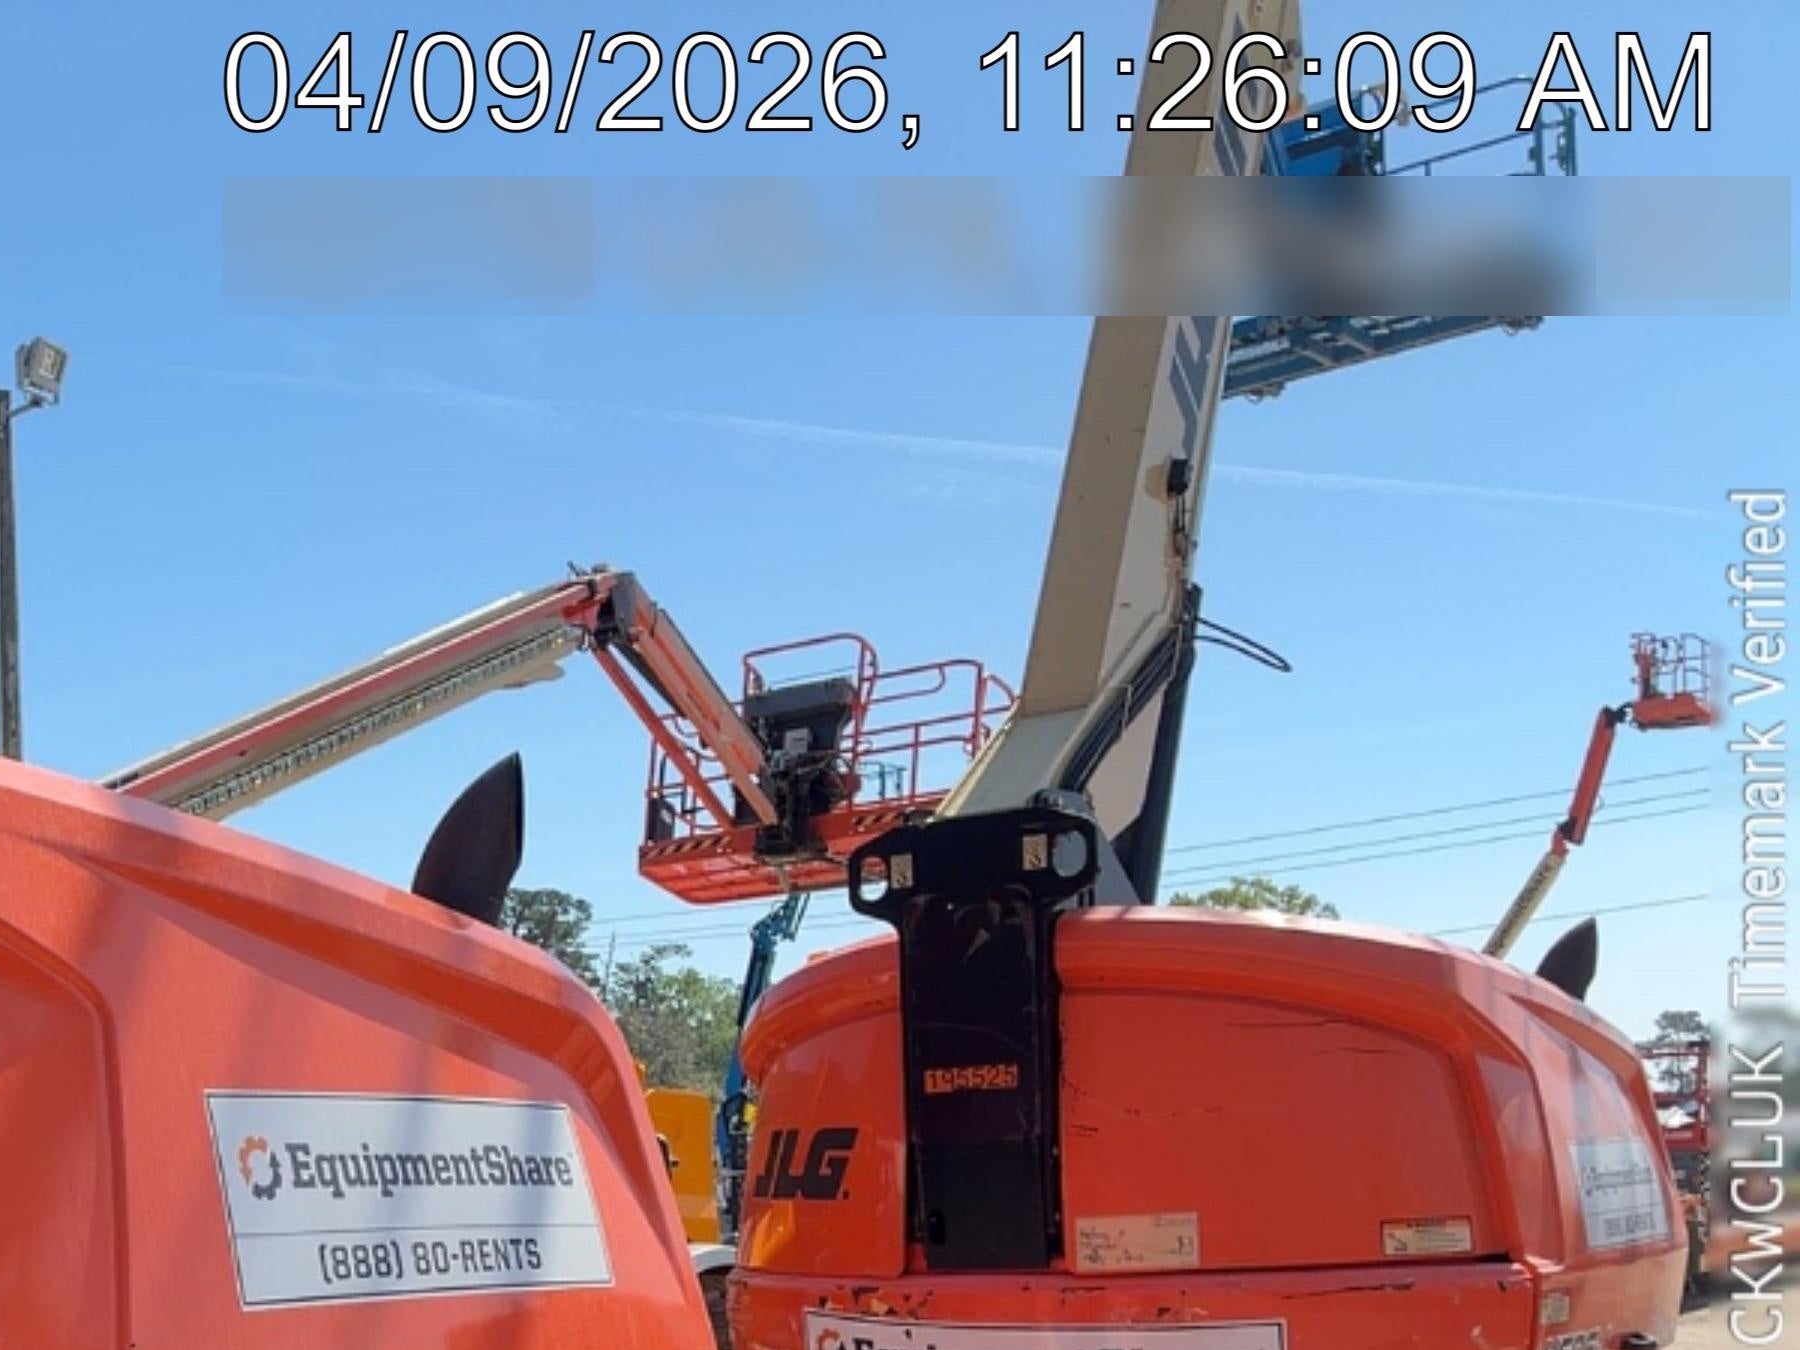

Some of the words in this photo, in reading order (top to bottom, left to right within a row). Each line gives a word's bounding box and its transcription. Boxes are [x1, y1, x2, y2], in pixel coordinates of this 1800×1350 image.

[284, 1142, 574, 1198] EquipmentShare
[753, 1127, 858, 1200] JLG
[319, 1240, 404, 1285] (888)
[413, 1238, 542, 1276] 80-RENTS
